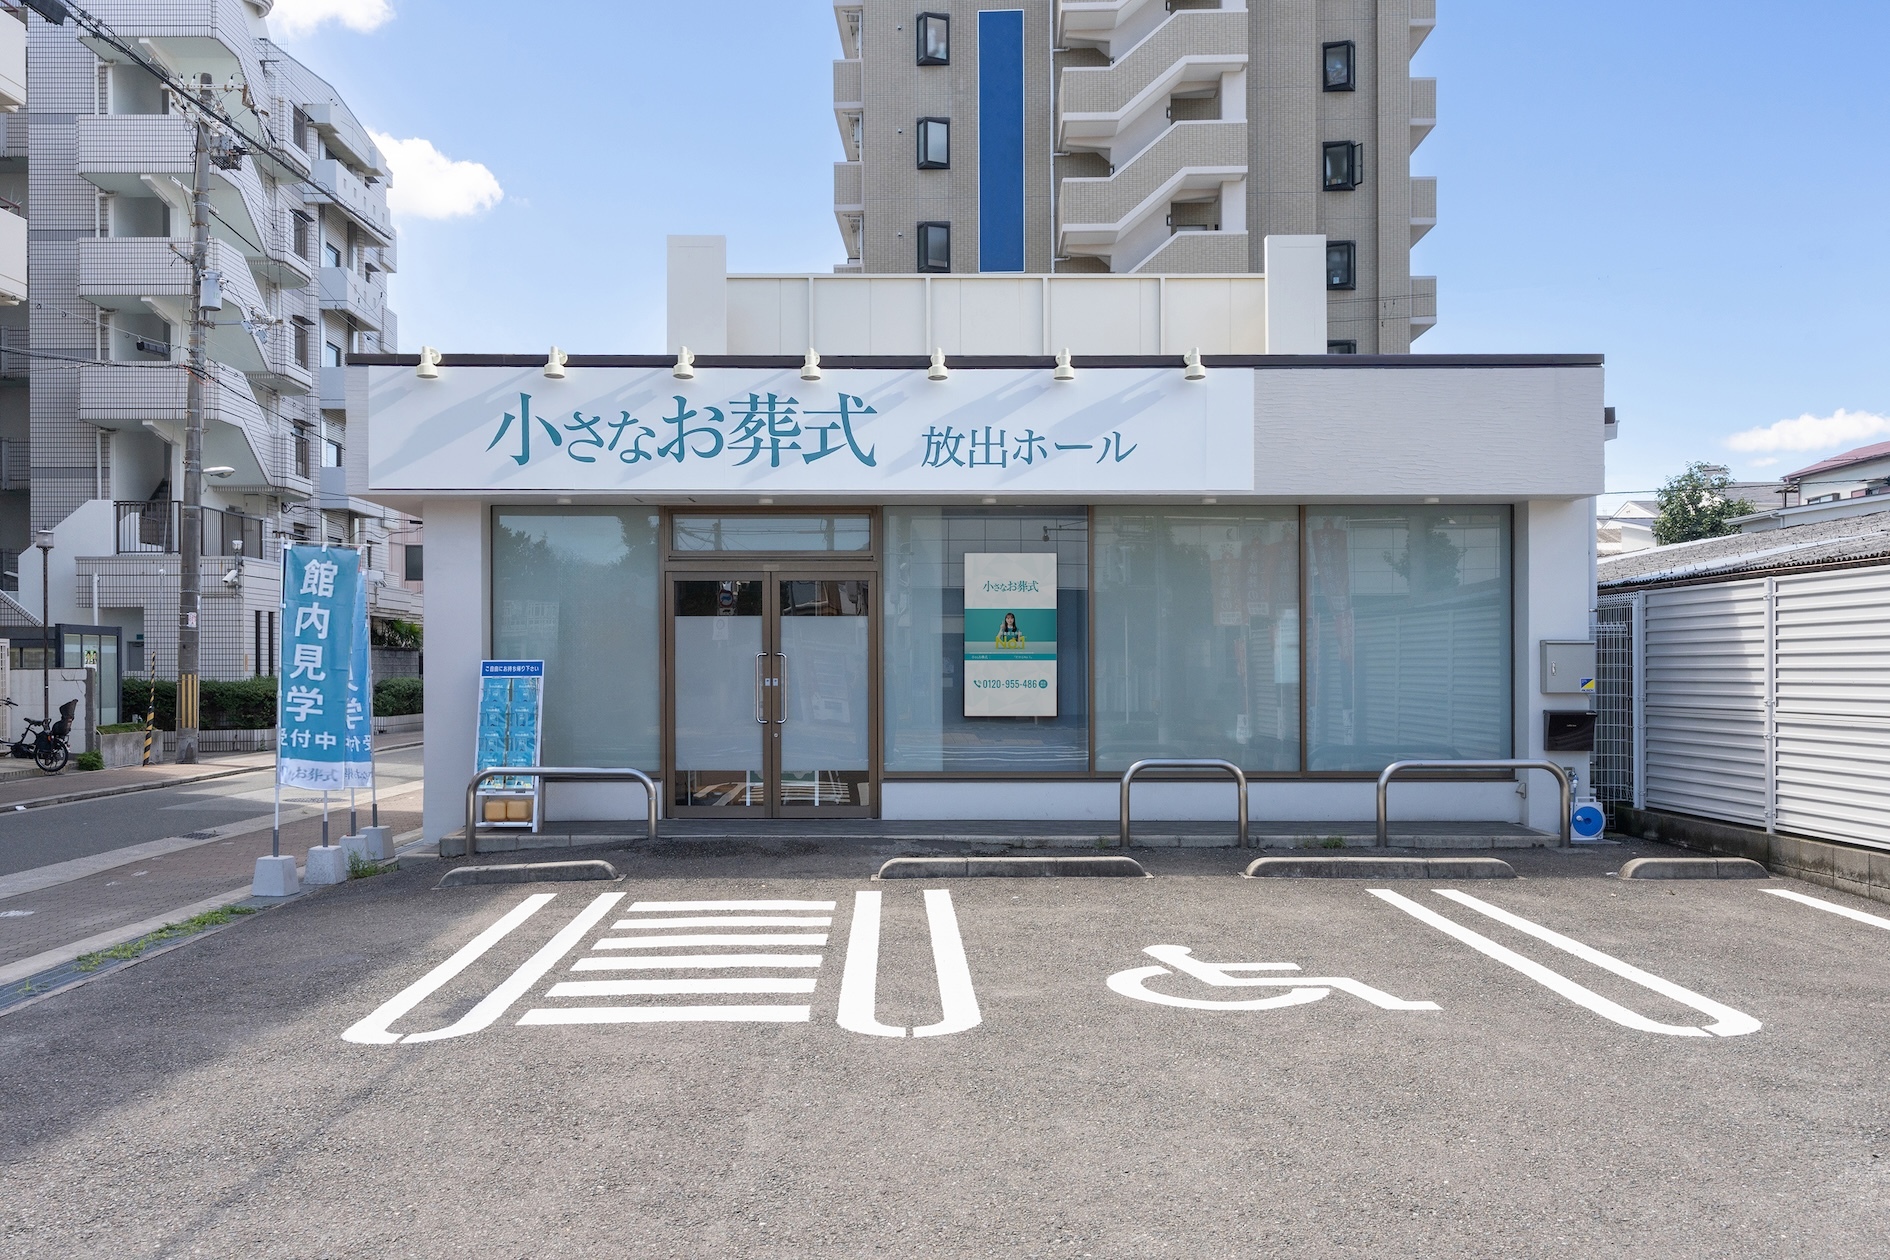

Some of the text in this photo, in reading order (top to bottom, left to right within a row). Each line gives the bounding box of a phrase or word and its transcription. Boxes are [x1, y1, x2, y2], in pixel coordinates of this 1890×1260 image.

[486, 392, 1137, 468] 小さなお葬式 放出ホール
[983, 580, 1039, 593] 小さなお葬式
[286, 559, 338, 722] 館内見学
[485, 665, 540, 673] ご自由にお持ち帰り下さい
[982, 679, 1037, 689] 0120-955-486
